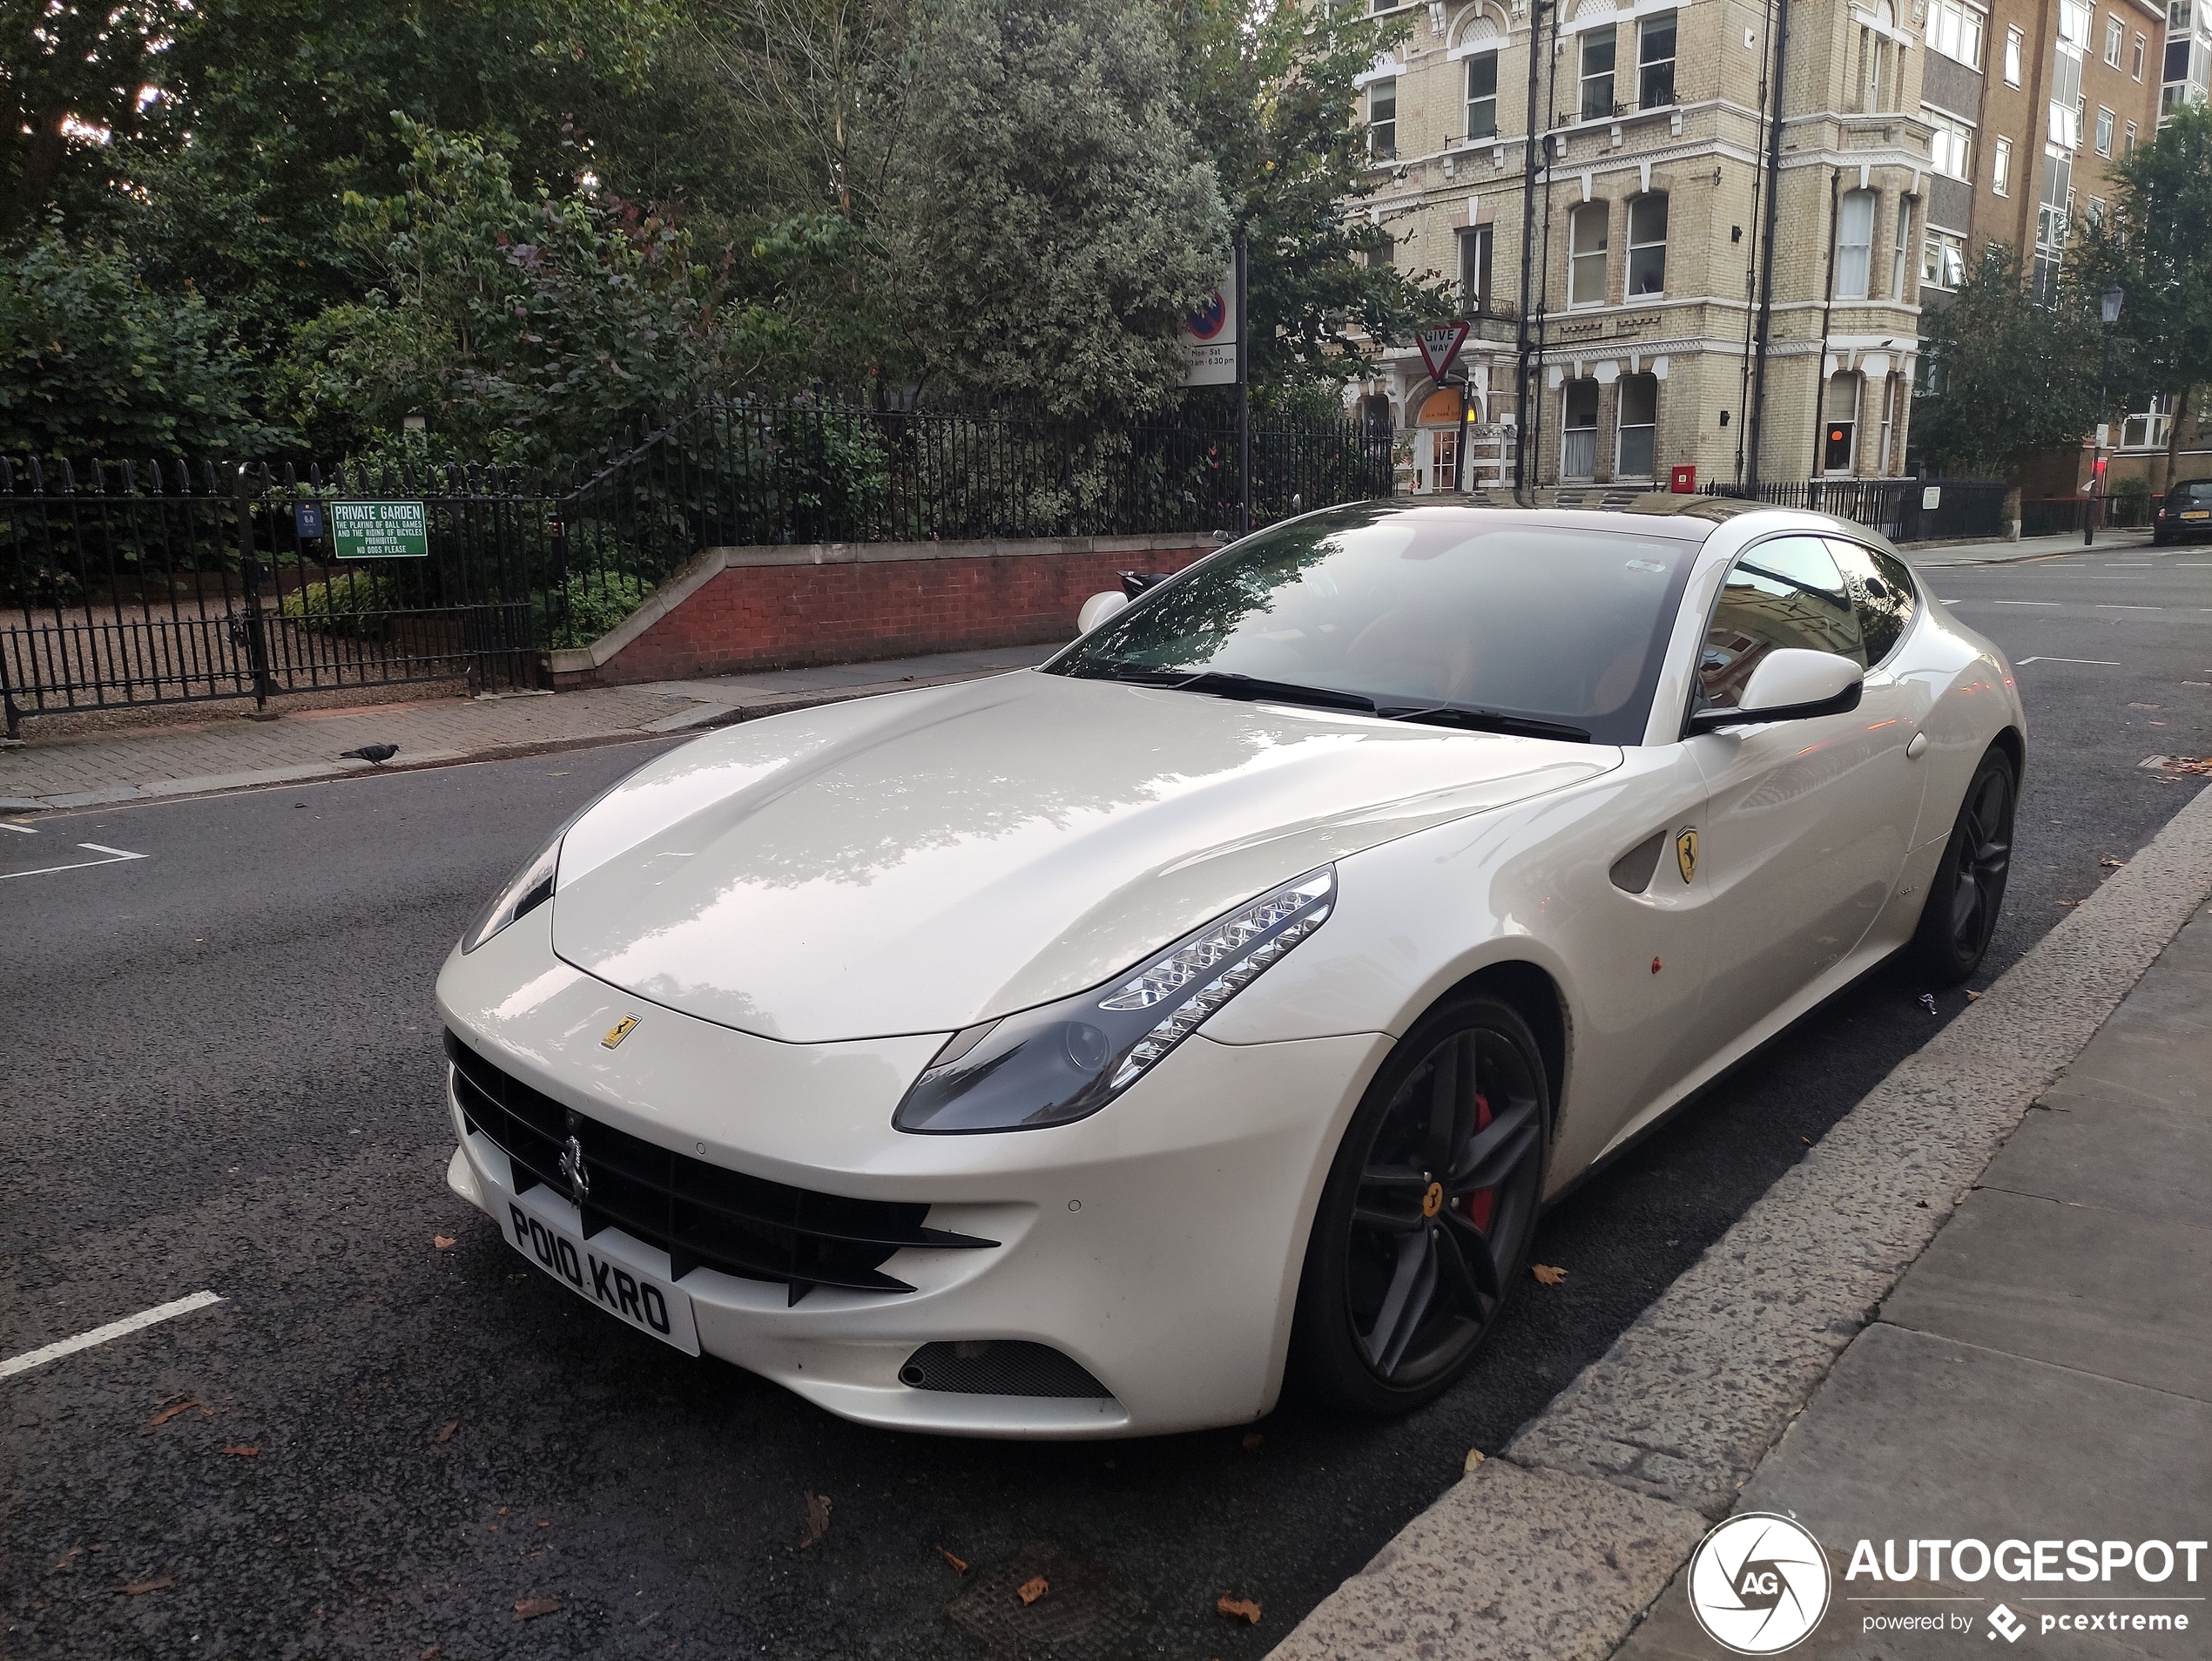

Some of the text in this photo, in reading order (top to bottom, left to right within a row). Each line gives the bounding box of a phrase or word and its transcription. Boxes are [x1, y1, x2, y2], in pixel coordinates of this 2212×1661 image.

[1425, 329, 1454, 341] GIVE
[1430, 343, 1449, 352] WAY
[335, 505, 421, 520] PRIVATE GARDEN
[509, 1201, 671, 1335] PO10 KRO
